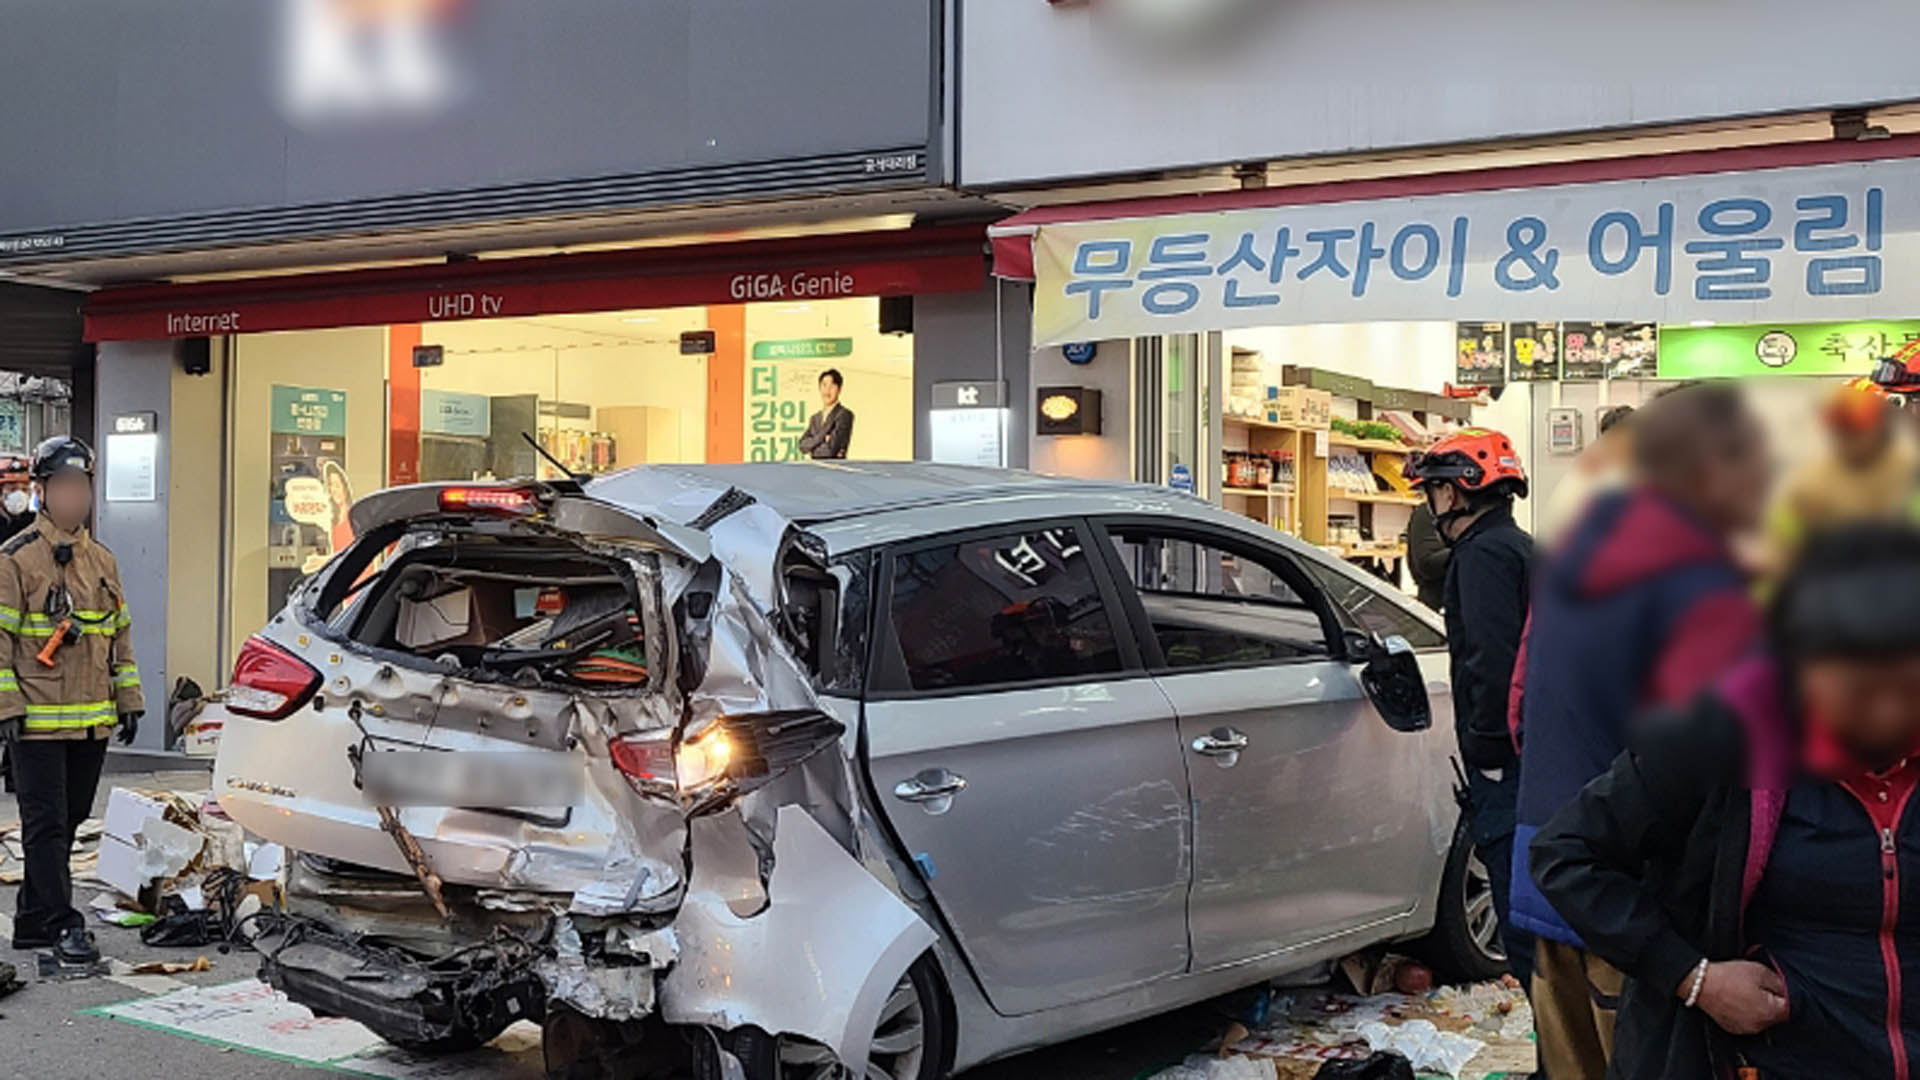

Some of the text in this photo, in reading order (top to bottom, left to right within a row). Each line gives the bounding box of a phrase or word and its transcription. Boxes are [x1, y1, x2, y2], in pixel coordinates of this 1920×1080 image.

[1065, 187, 1883, 320] 무등산자이 & 어울림
[731, 269, 854, 299] GiGA Genie
[429, 294, 503, 318] UHD tv
[167, 312, 241, 334] Internet
[751, 365, 777, 396] 더
[751, 401, 806, 433] 강인
